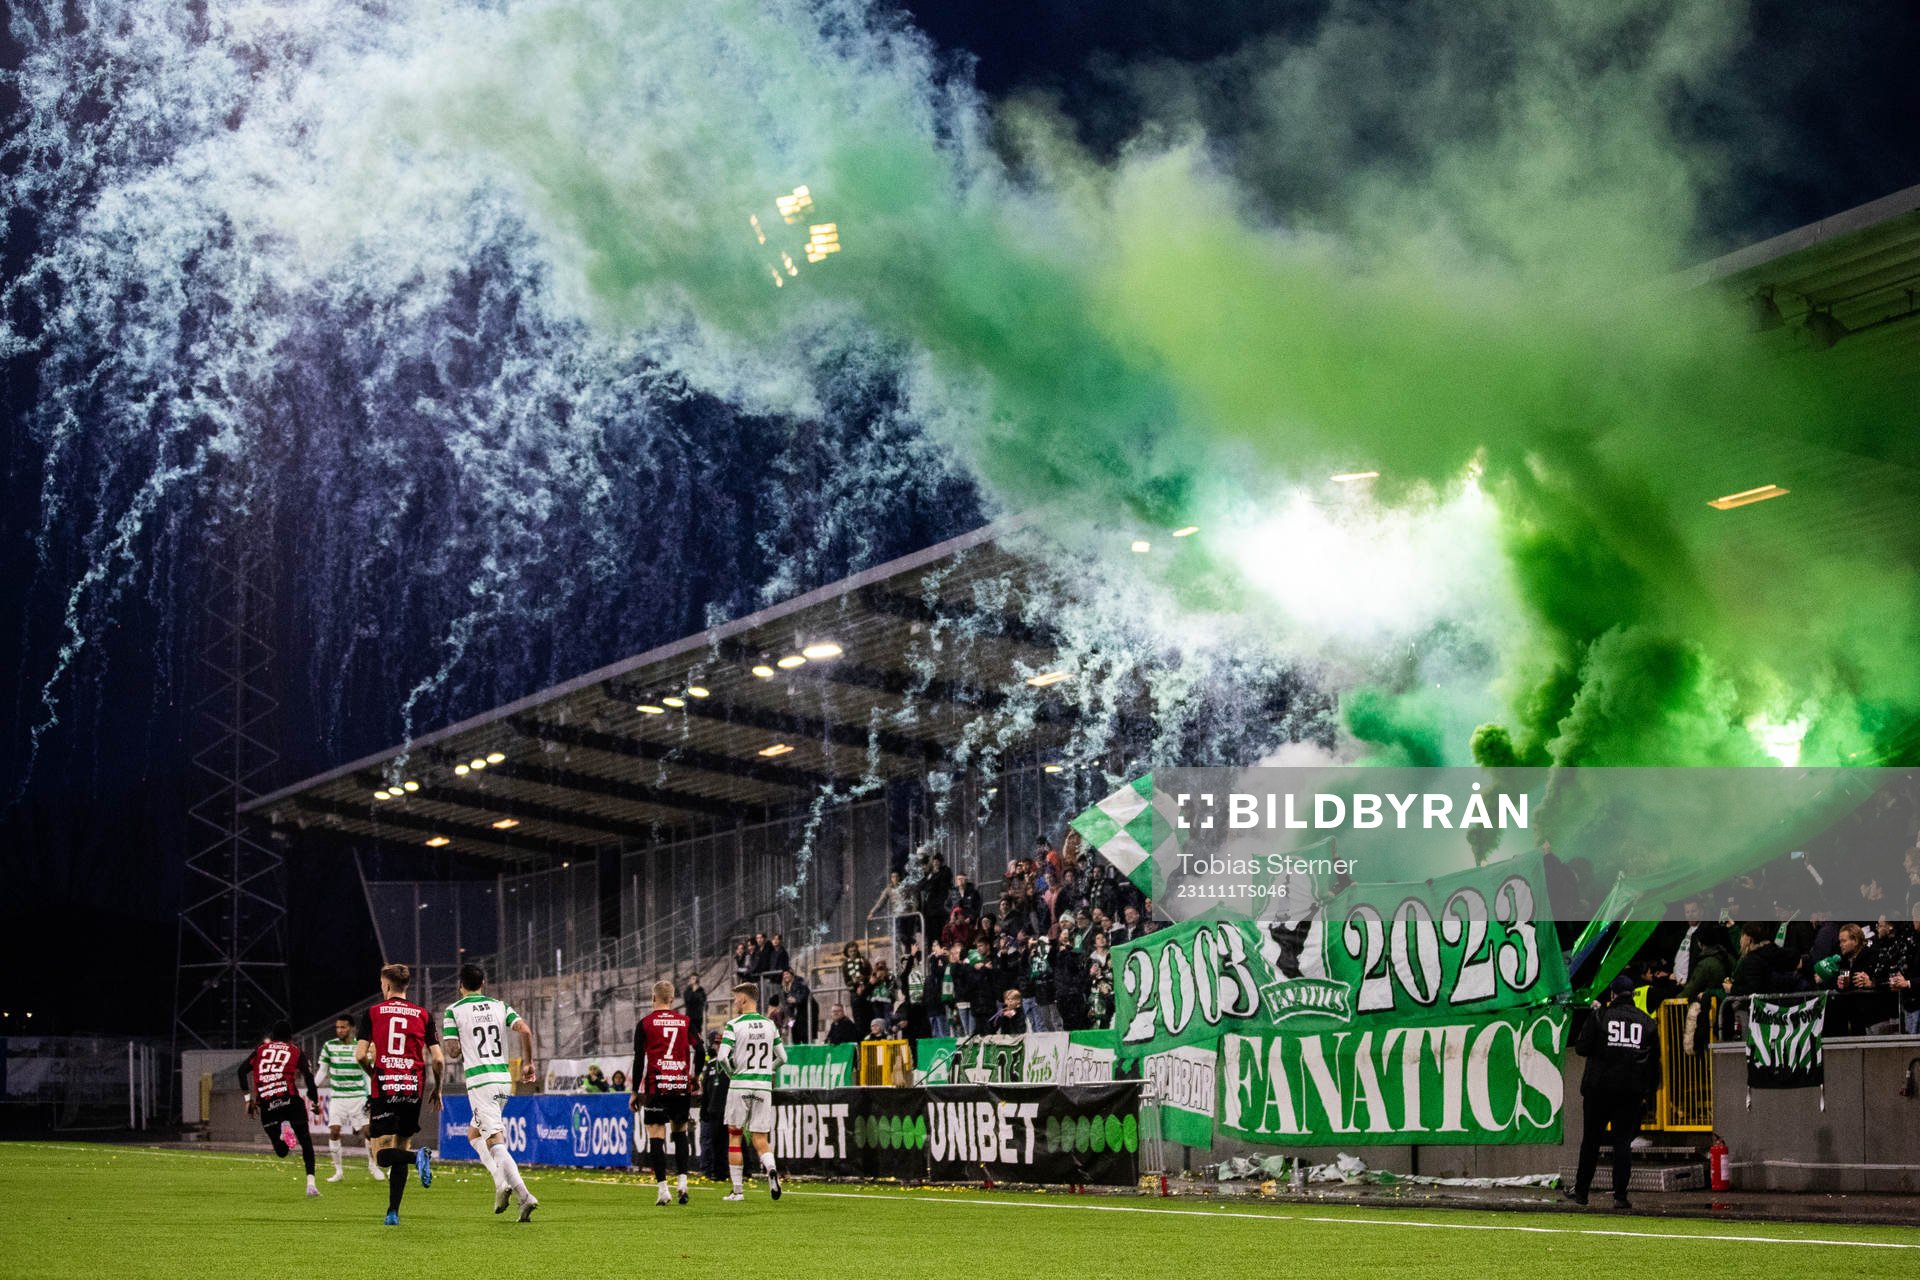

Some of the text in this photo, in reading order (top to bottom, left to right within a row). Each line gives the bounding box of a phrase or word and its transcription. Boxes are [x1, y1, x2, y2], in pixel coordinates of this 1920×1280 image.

[1122, 874, 1540, 1044] 2003 2023
[387, 1016, 408, 1055] 6
[472, 1024, 503, 1059] 23
[662, 1026, 679, 1060] 7
[1607, 1020, 1643, 1045] SLO
[258, 1048, 292, 1074] 29
[746, 1041, 769, 1070] 22
[382, 1083, 418, 1092] engcon
[657, 1082, 687, 1091] engcon
[1223, 1015, 1567, 1134] FANATICS
[592, 1117, 629, 1155] OBOS
[927, 1102, 1040, 1165] UNIBET
